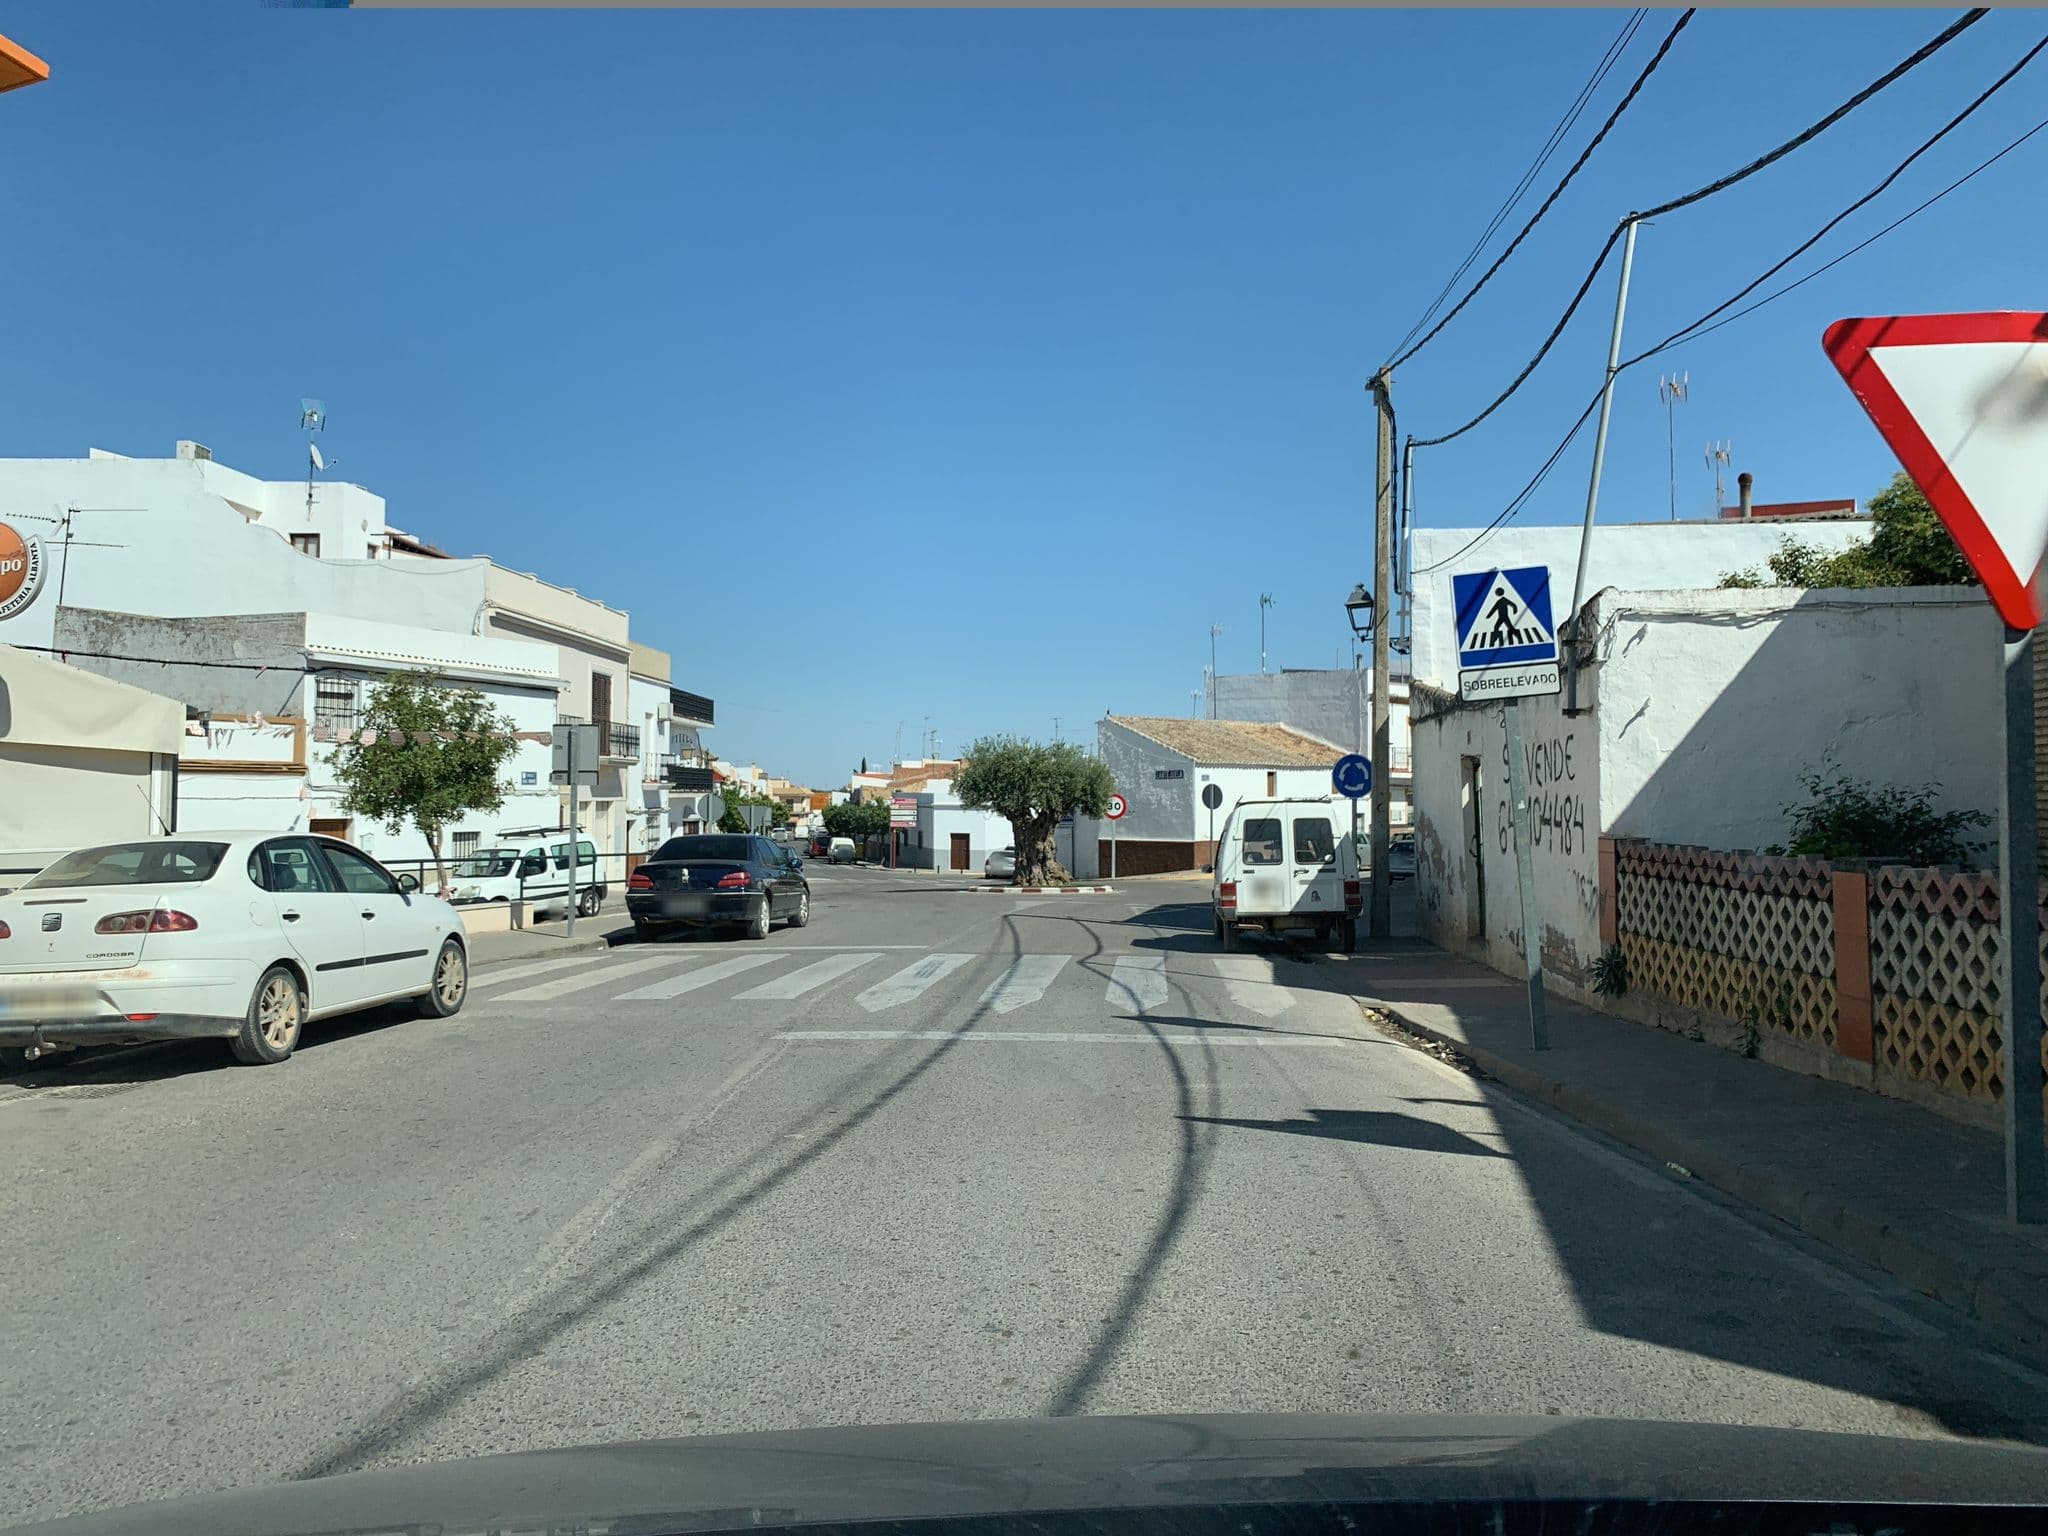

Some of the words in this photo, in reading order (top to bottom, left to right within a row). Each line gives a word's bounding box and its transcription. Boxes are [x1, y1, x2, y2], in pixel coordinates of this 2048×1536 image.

[28, 541, 39, 582] ALBANTA
[1463, 673, 1557, 692] SOBREELEVADO
[1524, 734, 1576, 788] VENDE
[1107, 802, 1121, 811] 30
[1498, 790, 1585, 856] 64104484
